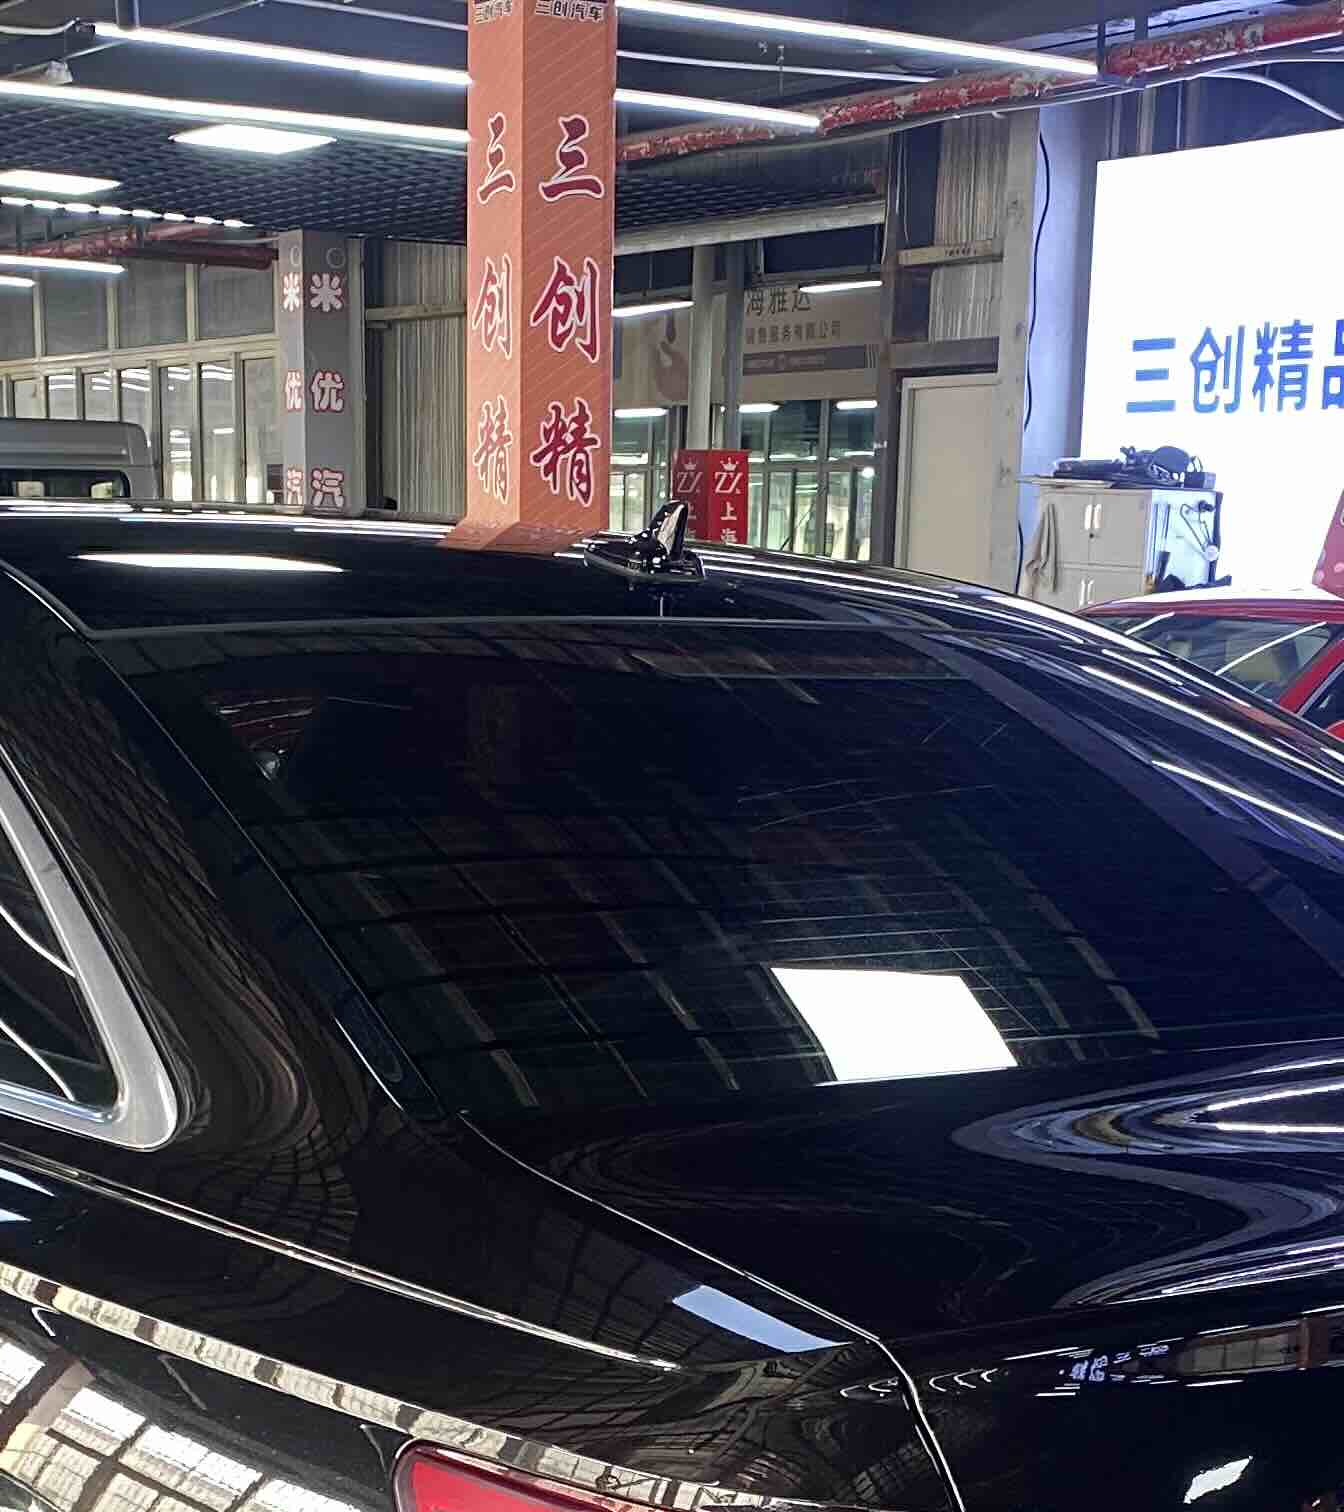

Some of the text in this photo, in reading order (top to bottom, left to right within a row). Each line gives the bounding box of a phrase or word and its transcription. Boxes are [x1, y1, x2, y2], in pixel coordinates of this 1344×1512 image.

[472, 111, 517, 506] 三创精
[529, 112, 605, 507] 三创精
